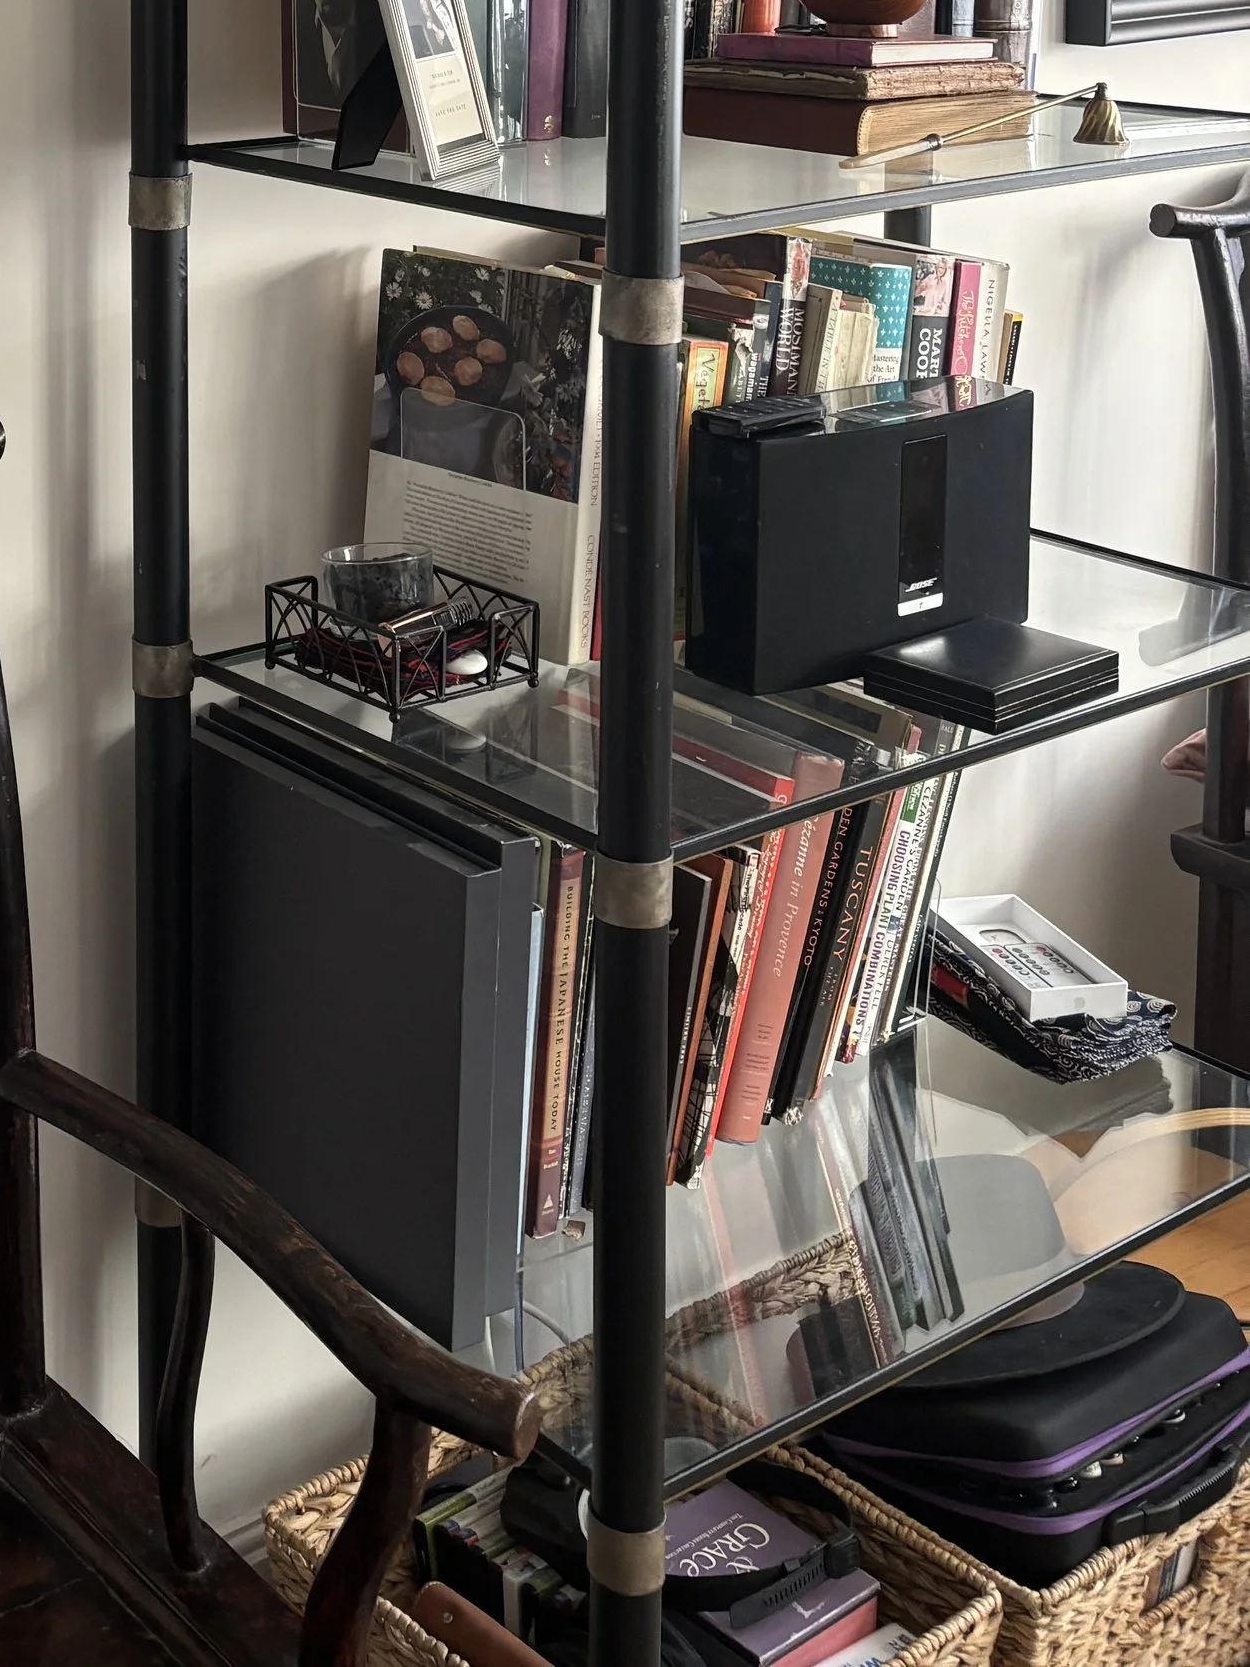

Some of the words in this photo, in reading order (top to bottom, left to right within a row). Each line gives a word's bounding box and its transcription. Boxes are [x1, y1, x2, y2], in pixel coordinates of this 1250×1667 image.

[983, 279, 996, 339] NIGELLA
[775, 307, 795, 371] WORLD
[872, 365, 884, 373] the
[884, 365, 895, 373] Art
[590, 458, 601, 507] EDITION
[583, 577, 592, 607] NAST
[905, 577, 938, 593] BOSE
[580, 610, 591, 648] BOOKS
[793, 817, 818, 878] ézanne
[886, 830, 911, 891] CHOOSING
[790, 882, 802, 898] in
[833, 846, 874, 961] TUSCANY
[895, 857, 914, 911] GARDEN
[562, 885, 574, 942] BUILDING
[561, 945, 570, 970] THE
[774, 900, 800, 979] Provence
[803, 918, 824, 967] KYOTO
[856, 932, 886, 1026] COMBINATIONS
[555, 971, 568, 1045] JAPANESE
[553, 1050, 561, 1087] HOUSE
[551, 1094, 559, 1132] TODAY
